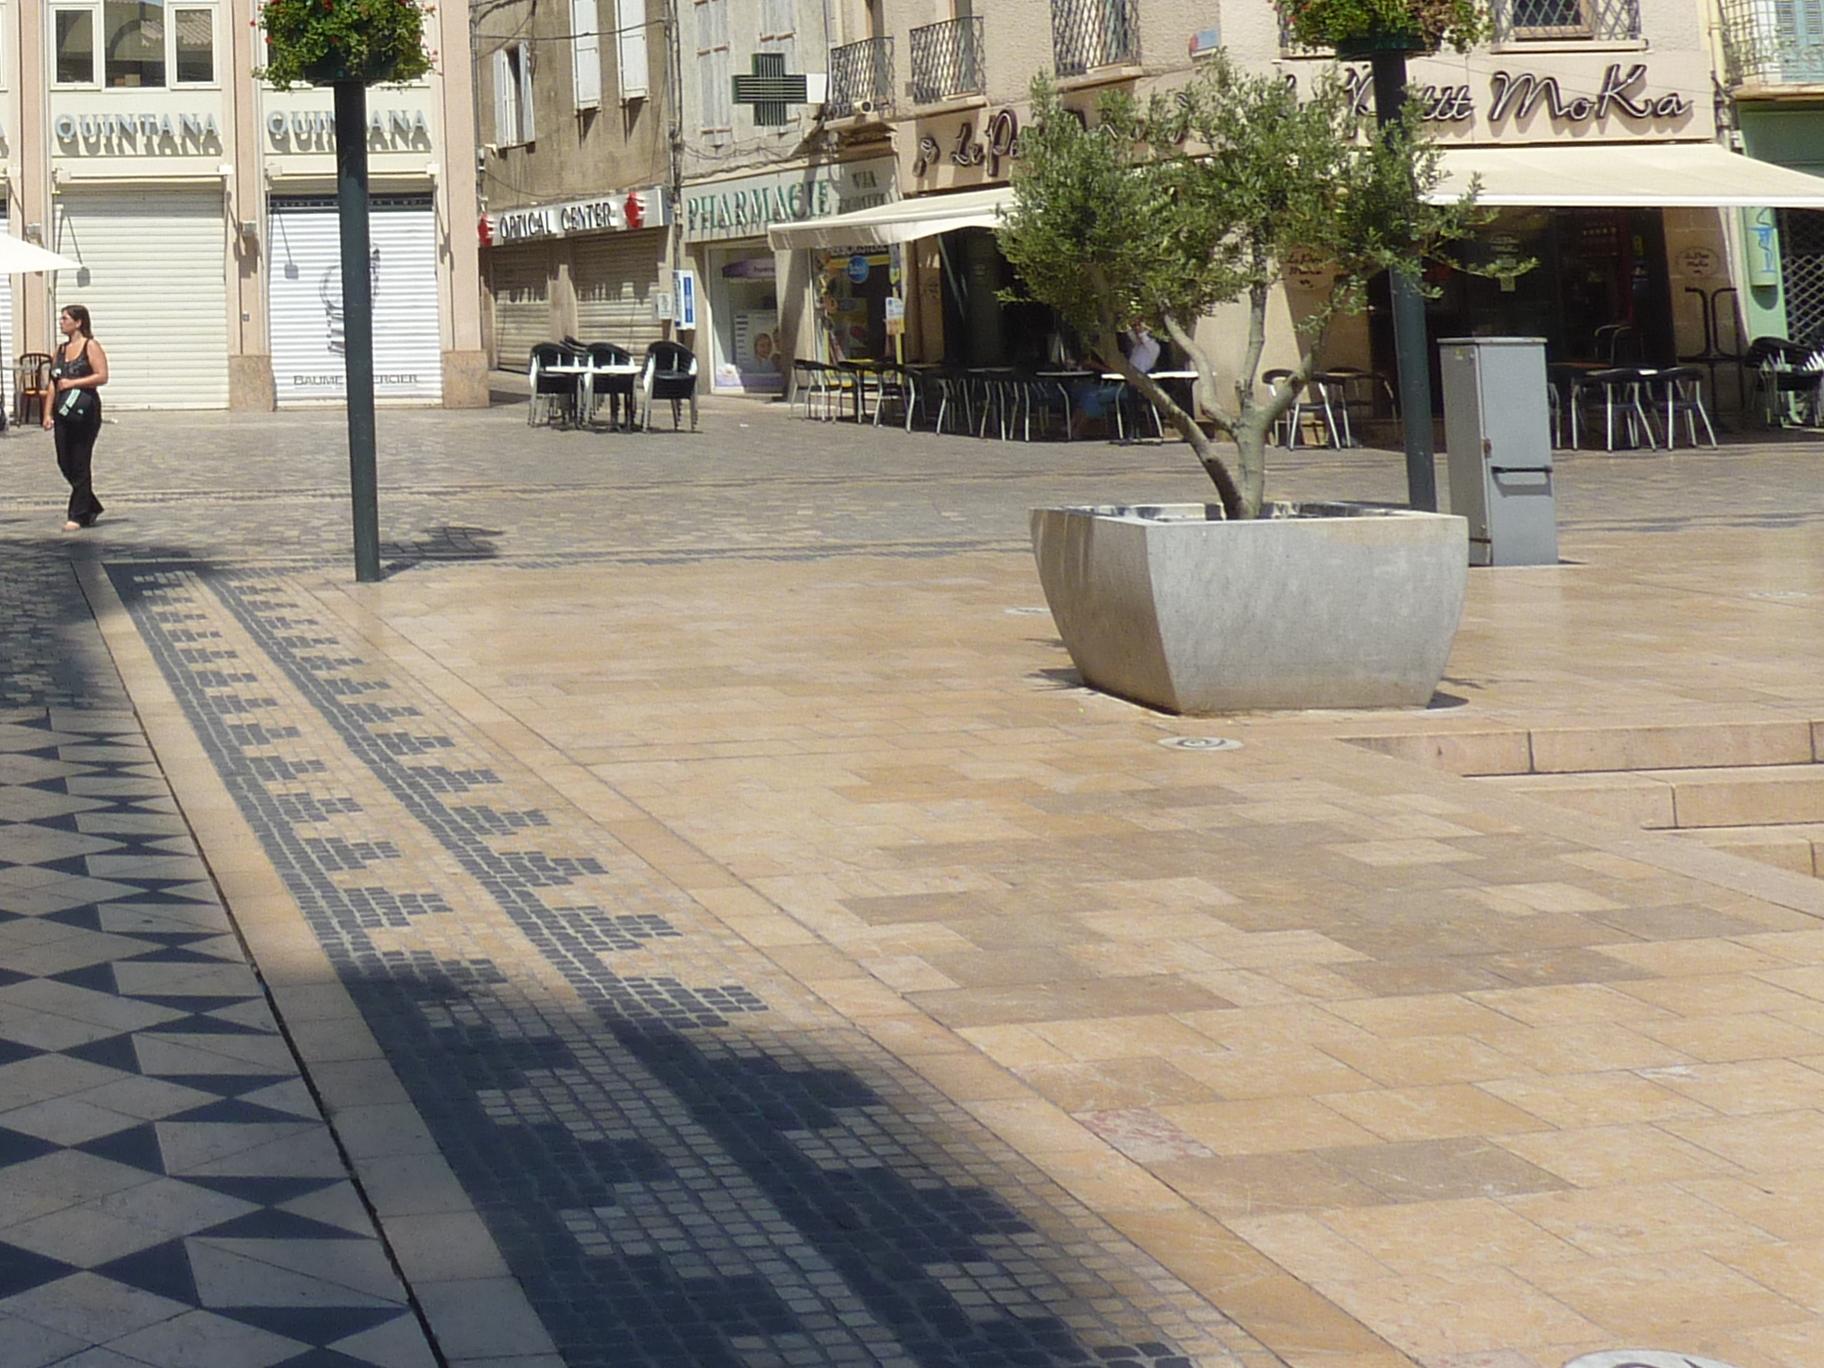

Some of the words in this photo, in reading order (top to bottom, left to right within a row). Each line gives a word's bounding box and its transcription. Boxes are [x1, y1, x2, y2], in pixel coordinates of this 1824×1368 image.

[55, 113, 222, 140] QUINTANA
[266, 109, 429, 137] QUIANA
[499, 210, 553, 239] OPTICAL
[560, 201, 612, 232] CENTER
[687, 180, 832, 232] PHARMACIE
[293, 375, 344, 386] BAUME
[373, 374, 419, 384] ERCIER
